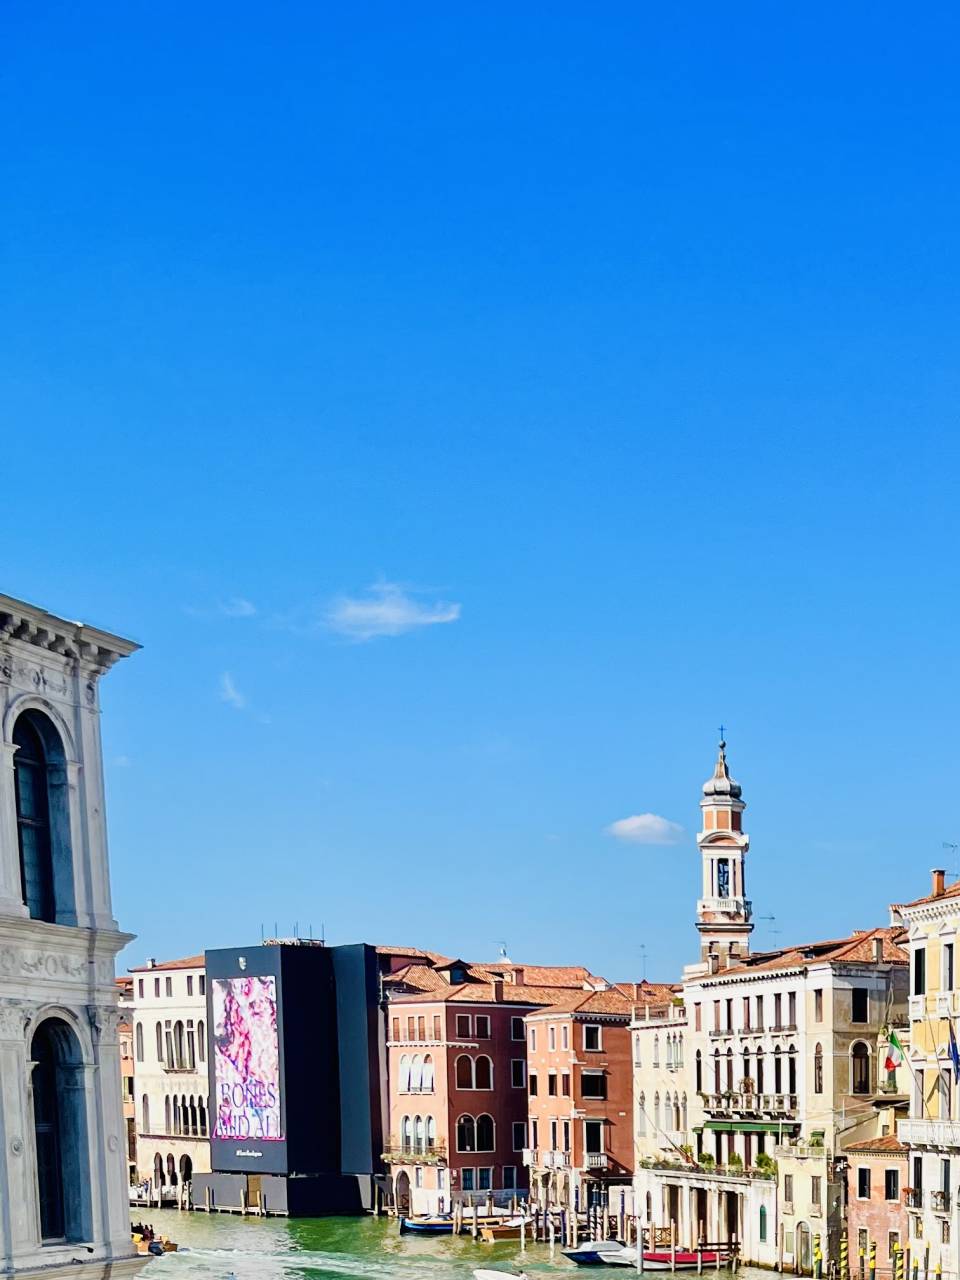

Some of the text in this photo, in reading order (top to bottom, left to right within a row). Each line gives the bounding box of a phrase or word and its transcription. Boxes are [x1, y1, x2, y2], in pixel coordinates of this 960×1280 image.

[221, 1080, 276, 1108] BONES
[212, 1112, 286, 1141] AND ALL
